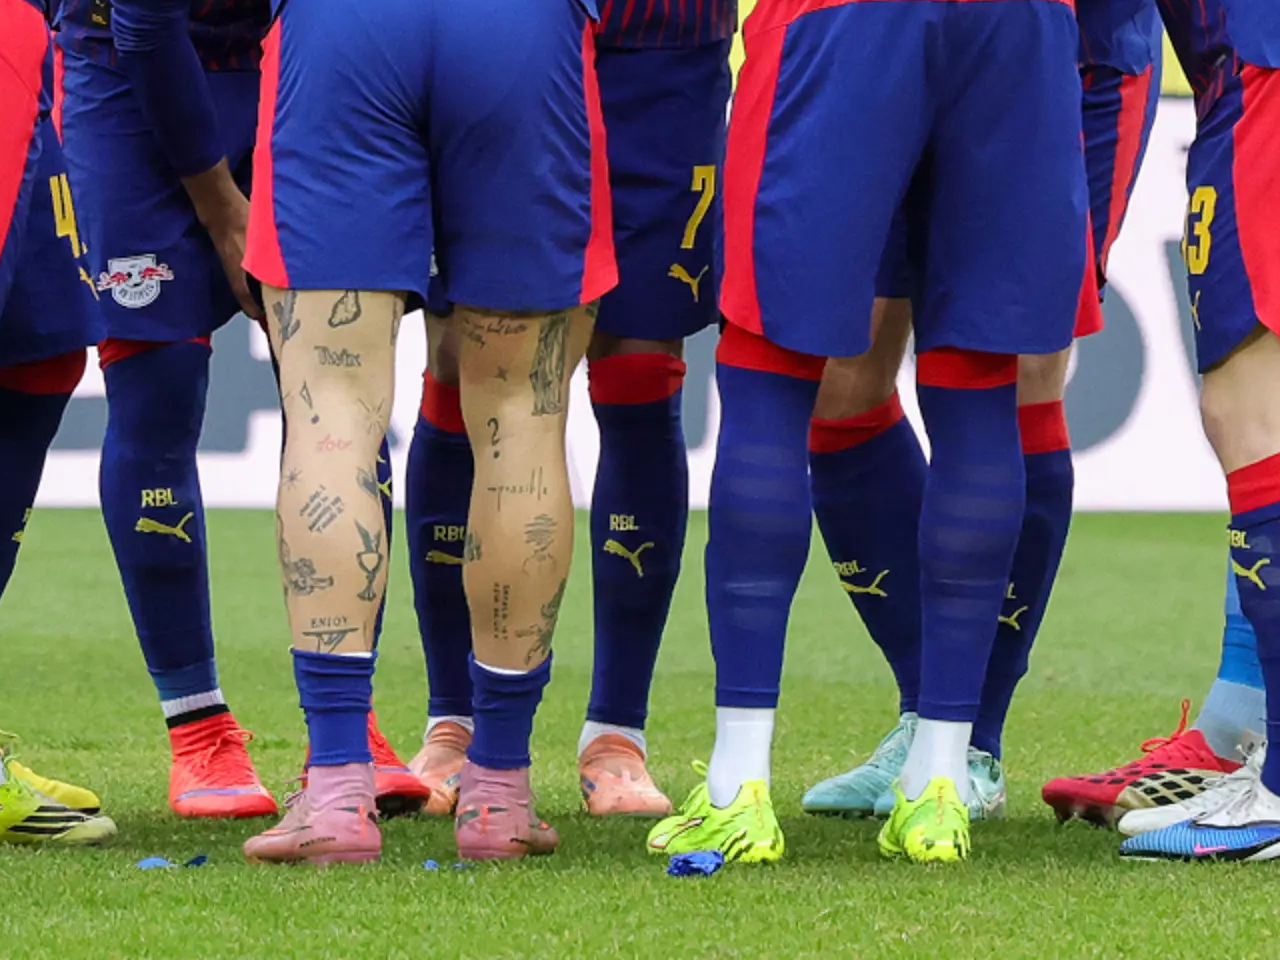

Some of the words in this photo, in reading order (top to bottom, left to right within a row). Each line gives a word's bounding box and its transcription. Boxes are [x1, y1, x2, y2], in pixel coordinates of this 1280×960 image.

[680, 165, 716, 249] 7
[141, 487, 179, 508] RBL
[609, 513, 640, 531] RBL
